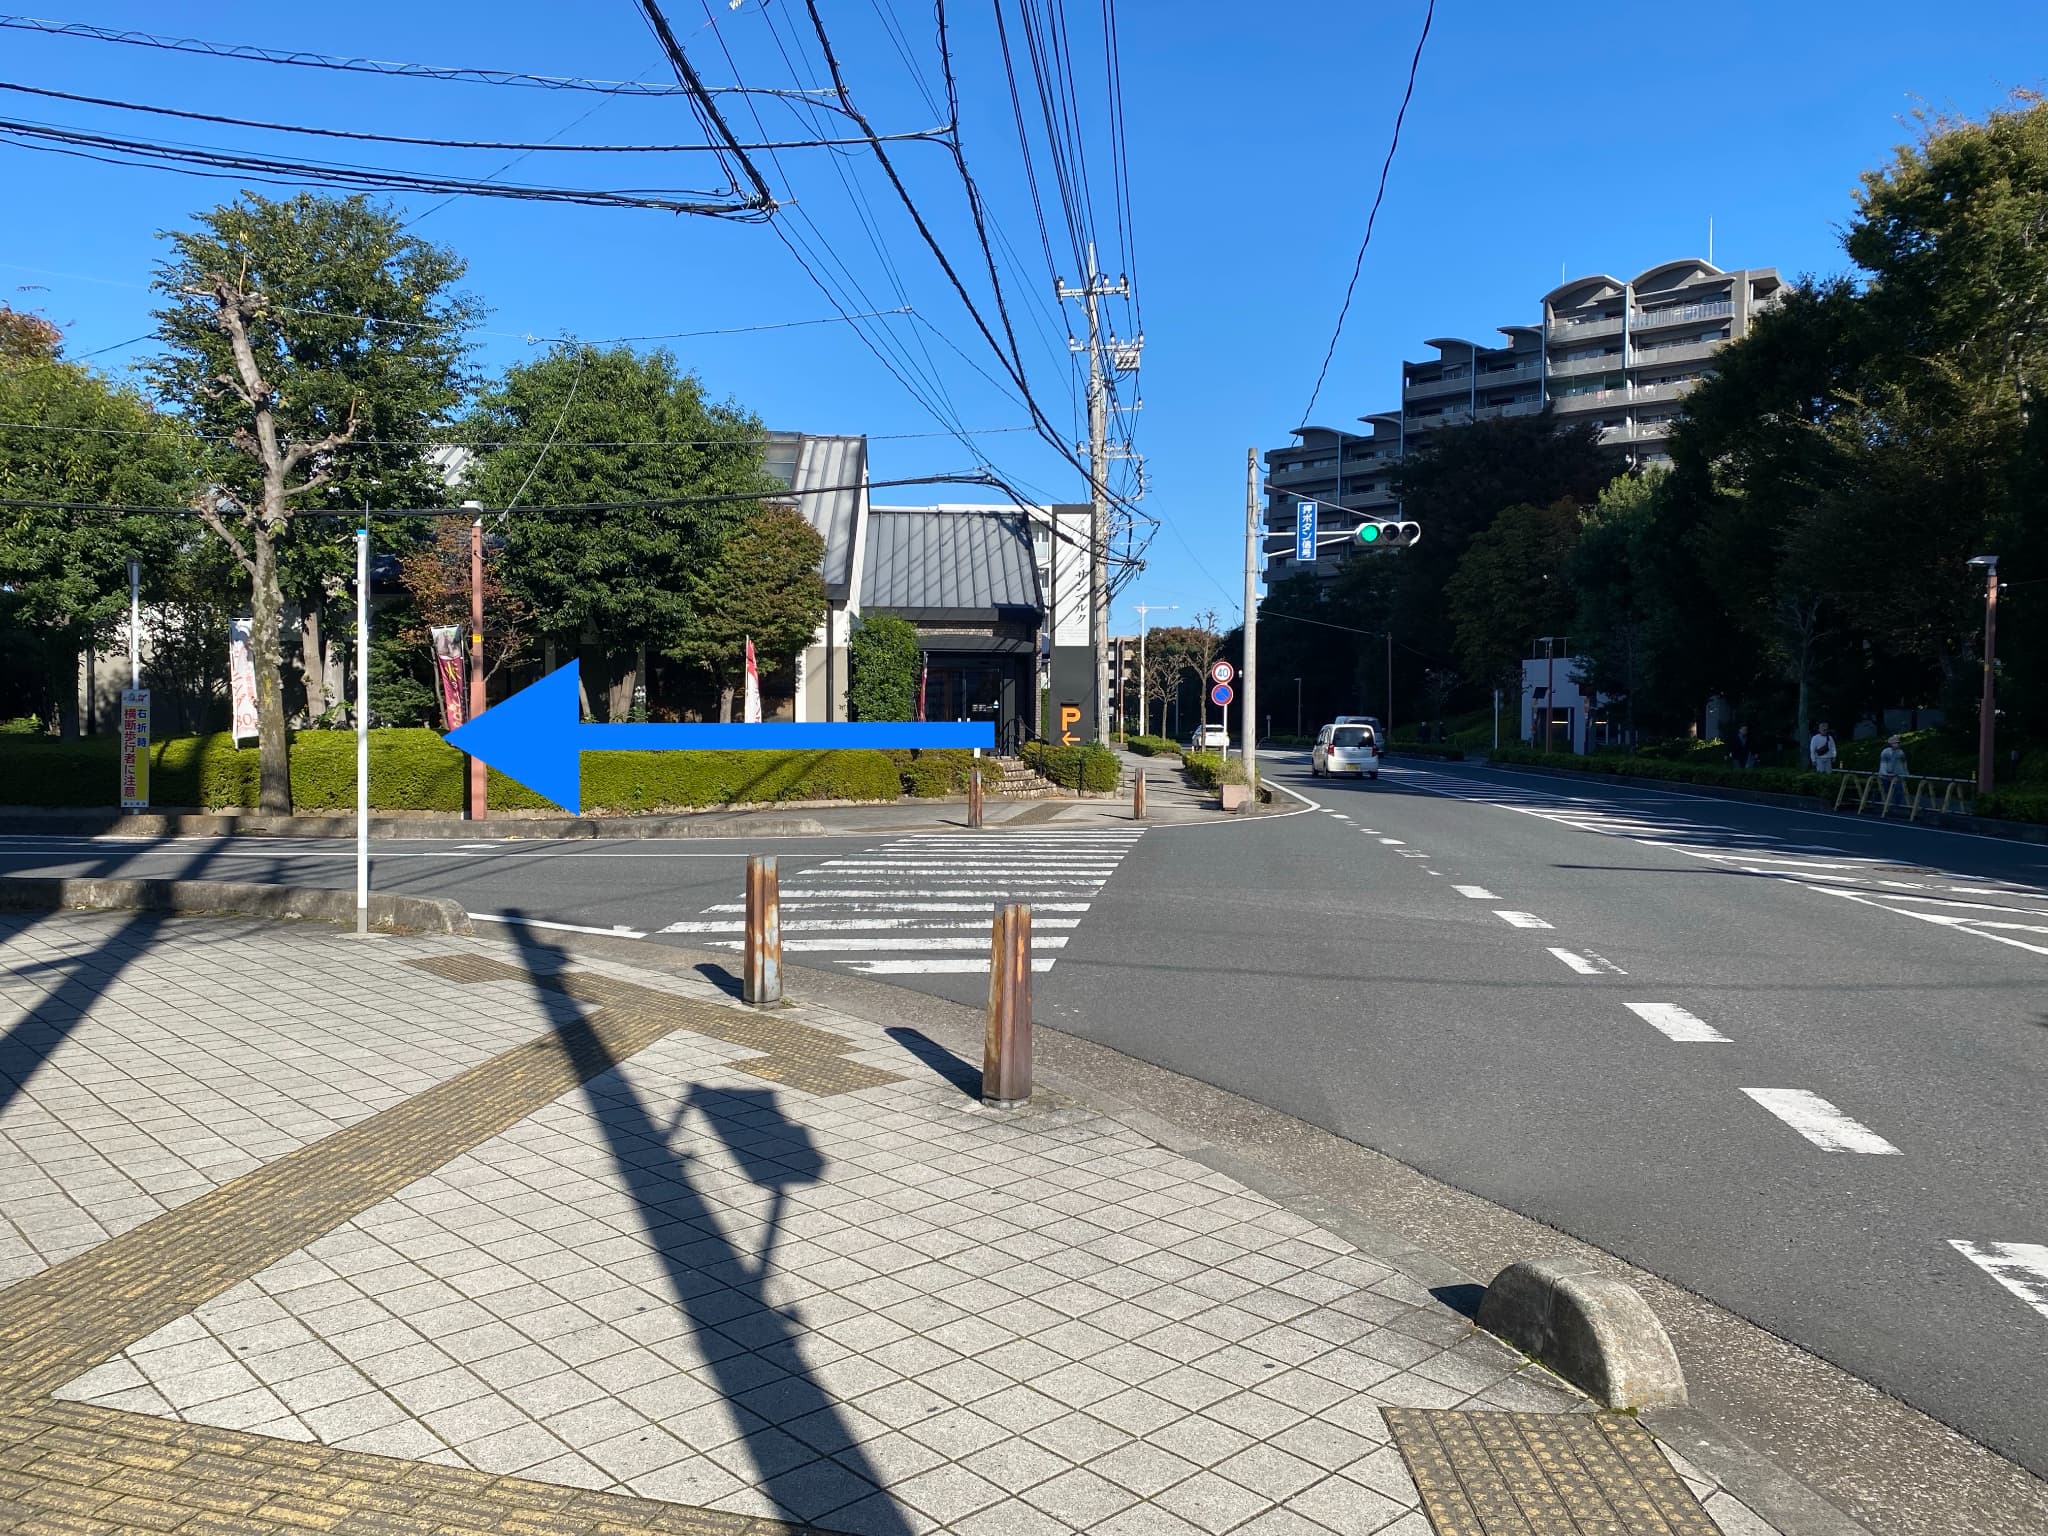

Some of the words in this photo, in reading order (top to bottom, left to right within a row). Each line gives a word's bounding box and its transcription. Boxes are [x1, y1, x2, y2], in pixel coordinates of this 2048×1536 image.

[1302, 504, 1313, 558] 押ボタン信号
[1074, 569, 1089, 625] サンマルク
[1217, 668, 1228, 677] 40
[137, 709, 147, 748] 右折時
[1062, 707, 1080, 731] P
[124, 708, 136, 798] 横断歩行者に注意
